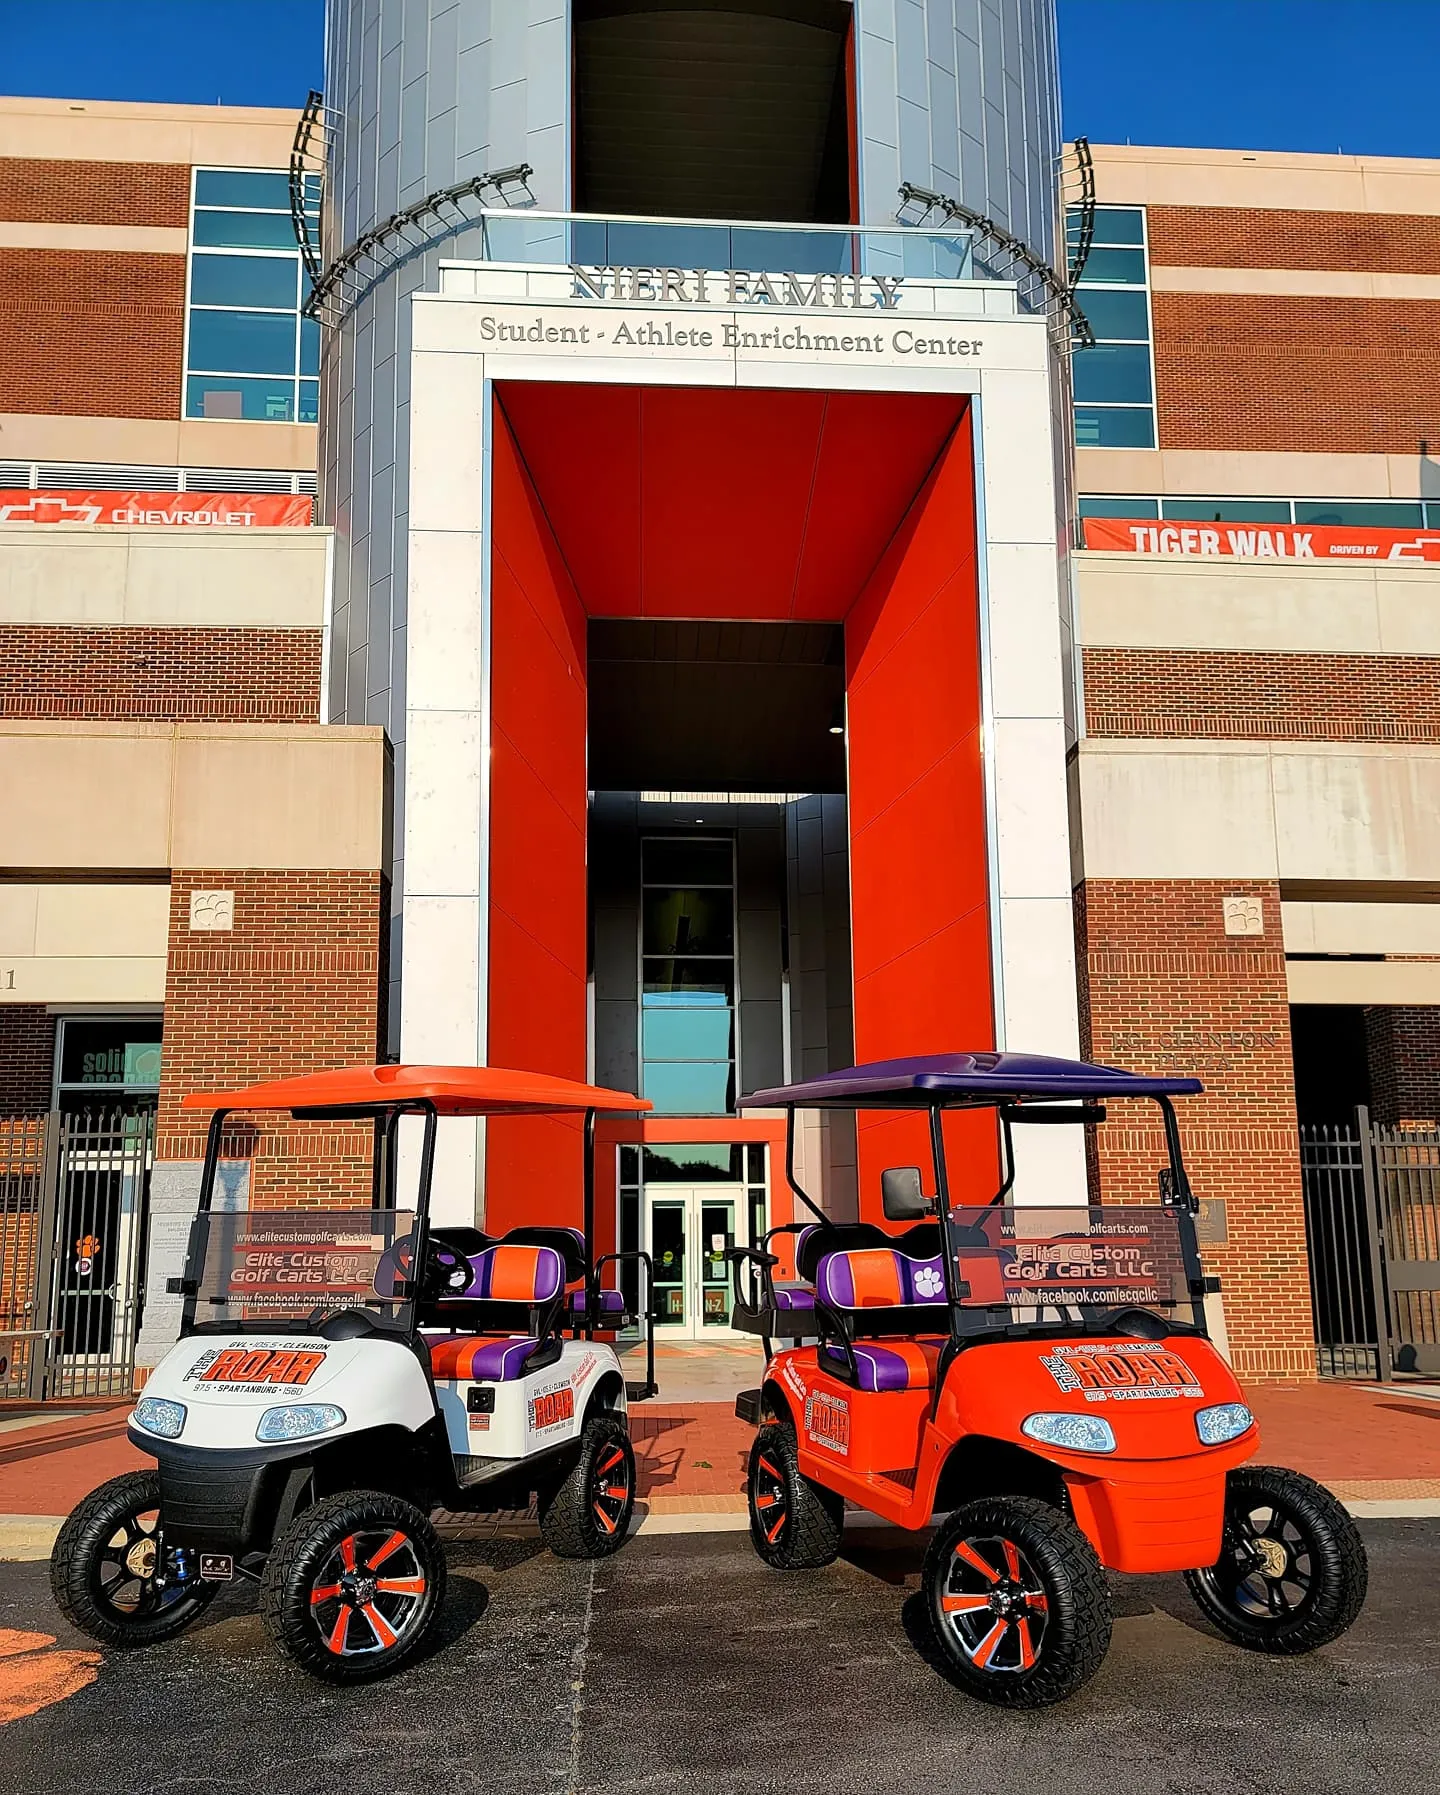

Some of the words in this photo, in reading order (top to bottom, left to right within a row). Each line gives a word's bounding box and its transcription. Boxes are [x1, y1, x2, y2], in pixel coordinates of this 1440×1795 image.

[568, 263, 712, 303] NIERI
[726, 270, 906, 310] FAMILY
[480, 316, 591, 344] Student
[612, 321, 713, 347] Athlete
[721, 323, 884, 353] Enrichment
[892, 330, 983, 356] Center
[111, 509, 256, 526] CHEVROLET
[1129, 526, 1221, 556] TIGER
[1227, 529, 1316, 559] WALK
[1329, 544, 1364, 555] DRIVEN
[1365, 545, 1379, 555] BY
[1155, 1053, 1234, 1071] PLAZA
[245, 1252, 284, 1267] Elite
[290, 1252, 359, 1267] Custom
[1018, 1245, 1061, 1261] Elite
[1068, 1245, 1140, 1261] Custom
[230, 1268, 272, 1283] Golf
[275, 1268, 323, 1283] Carts
[331, 1269, 370, 1283] LLC
[1004, 1262, 1050, 1279] Golf
[1056, 1262, 1108, 1278] Carts
[1115, 1262, 1154, 1277] LLC
[283, 1342, 331, 1351] CLEMSON
[1113, 1344, 1164, 1352] CLEMSON
[200, 1349, 327, 1386] ROAR
[1063, 1352, 1200, 1389] ROAR
[217, 1384, 278, 1394] SPARTANBURG
[1112, 1389, 1178, 1400] SPARTANBURG
[534, 1387, 575, 1430] ROAR
[811, 1399, 850, 1448] ROAR
